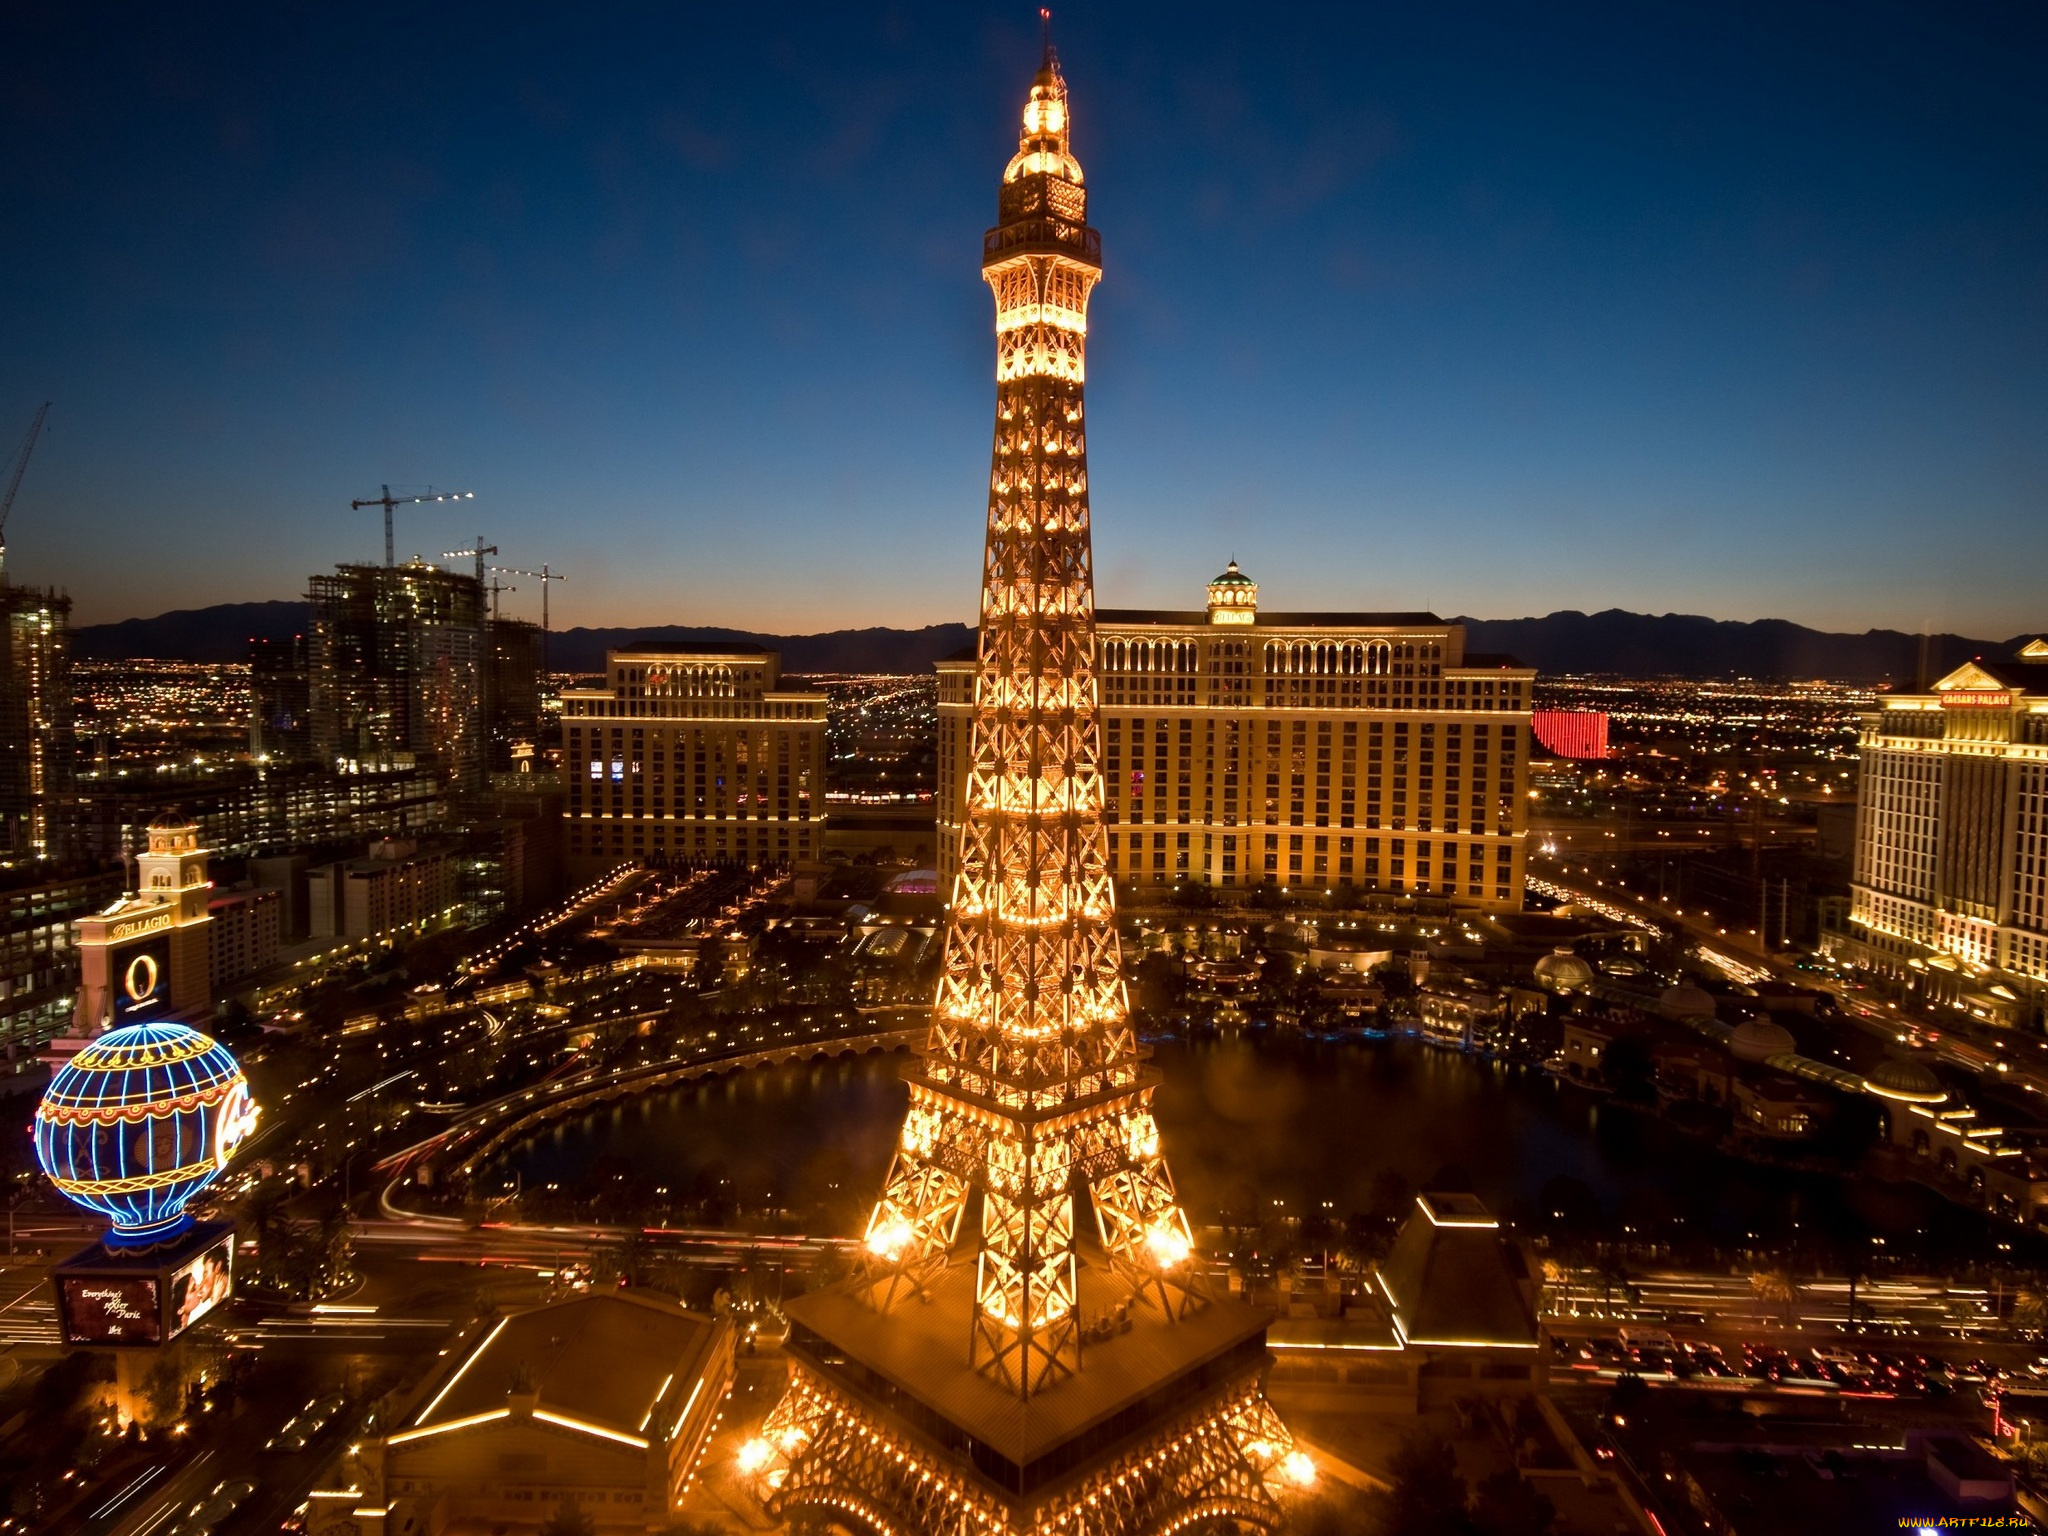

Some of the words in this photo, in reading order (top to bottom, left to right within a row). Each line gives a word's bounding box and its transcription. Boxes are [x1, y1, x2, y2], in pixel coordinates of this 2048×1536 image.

[1943, 694, 1976, 705] CAESARS
[1977, 694, 2010, 705] PALACE
[109, 914, 171, 940] BELLAGIO
[125, 954, 157, 1001] O
